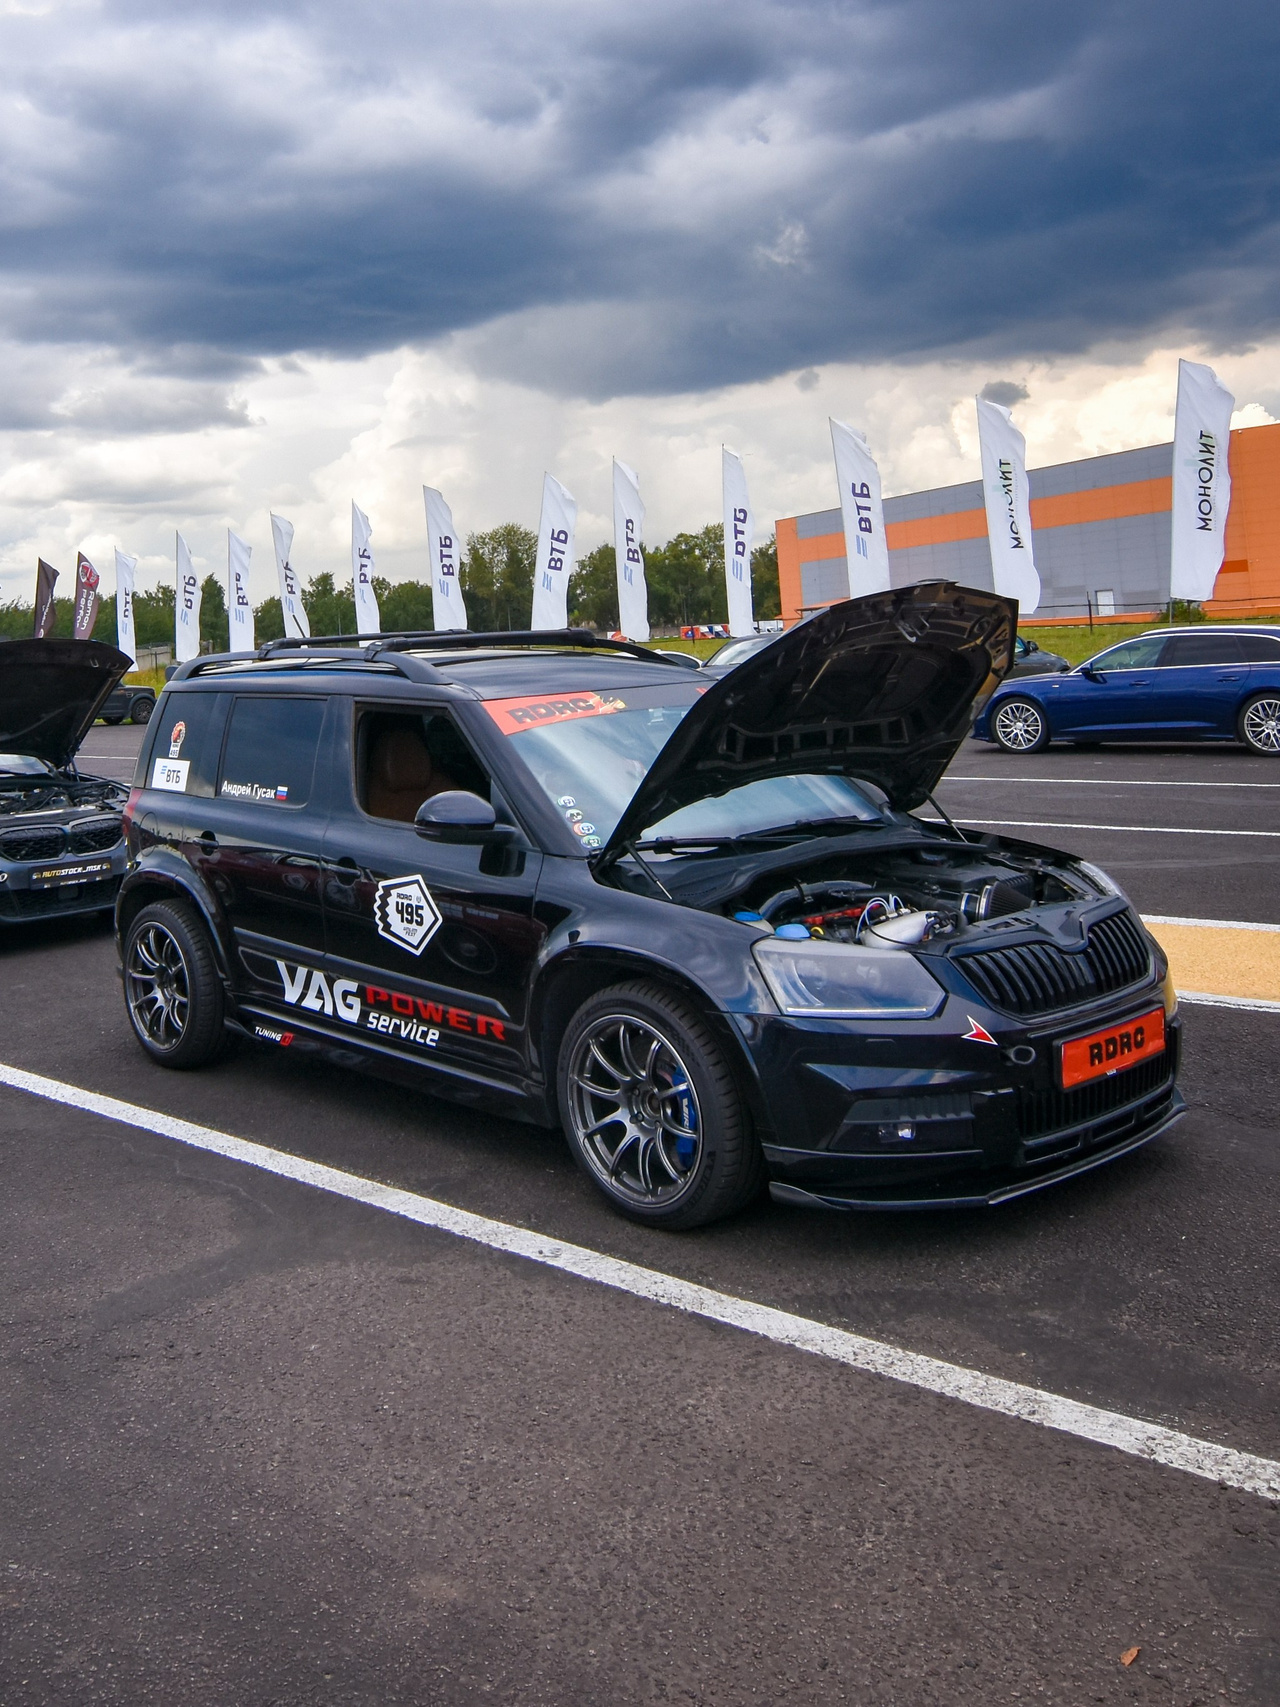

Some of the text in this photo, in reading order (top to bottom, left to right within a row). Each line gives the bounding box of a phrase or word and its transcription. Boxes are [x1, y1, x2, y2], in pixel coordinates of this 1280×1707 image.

[1196, 429, 1216, 532] МОНОЛИТ
[851, 481, 873, 534] ВТБ
[439, 535, 455, 577] ВТБ
[547, 527, 569, 572] ВТБ
[80, 590, 95, 631] Ramon
[507, 698, 596, 724] RDRC
[166, 768, 181, 784] ВТБ
[221, 780, 276, 800] Андрей Гусак
[395, 900, 424, 927] 495
[276, 960, 361, 1024] VAG
[365, 985, 506, 1041] POWER
[367, 1012, 440, 1047] service
[254, 1026, 283, 1042] TUNING
[1088, 1026, 1145, 1067] RDRC
